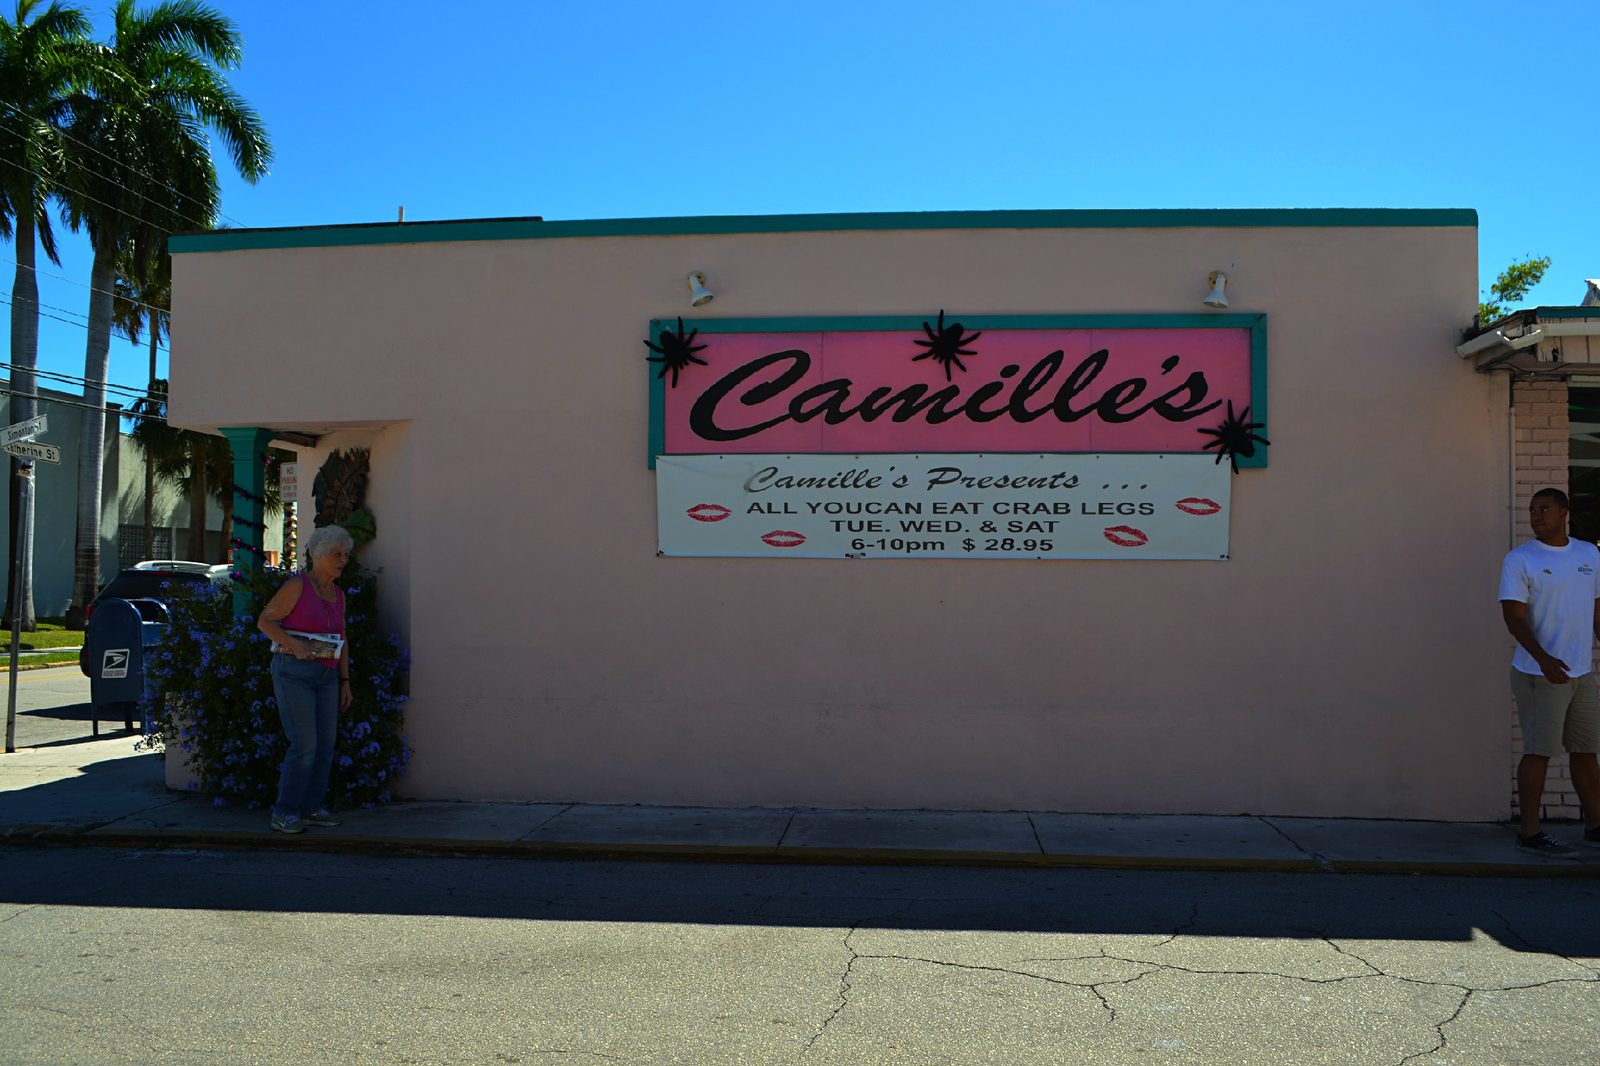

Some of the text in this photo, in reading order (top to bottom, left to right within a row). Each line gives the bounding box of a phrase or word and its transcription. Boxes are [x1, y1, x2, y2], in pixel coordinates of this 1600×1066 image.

[690, 348, 1223, 442] Camille's
[47, 448, 55, 460] St
[743, 466, 909, 493] Camille's
[927, 466, 1080, 491] Presents
[746, 502, 1155, 516] ALL YOUCAN EAT CRAB LEGS
[829, 519, 1060, 534] TUE. WED. & SAT
[851, 537, 1054, 554] 6-10pm $ 28.95
